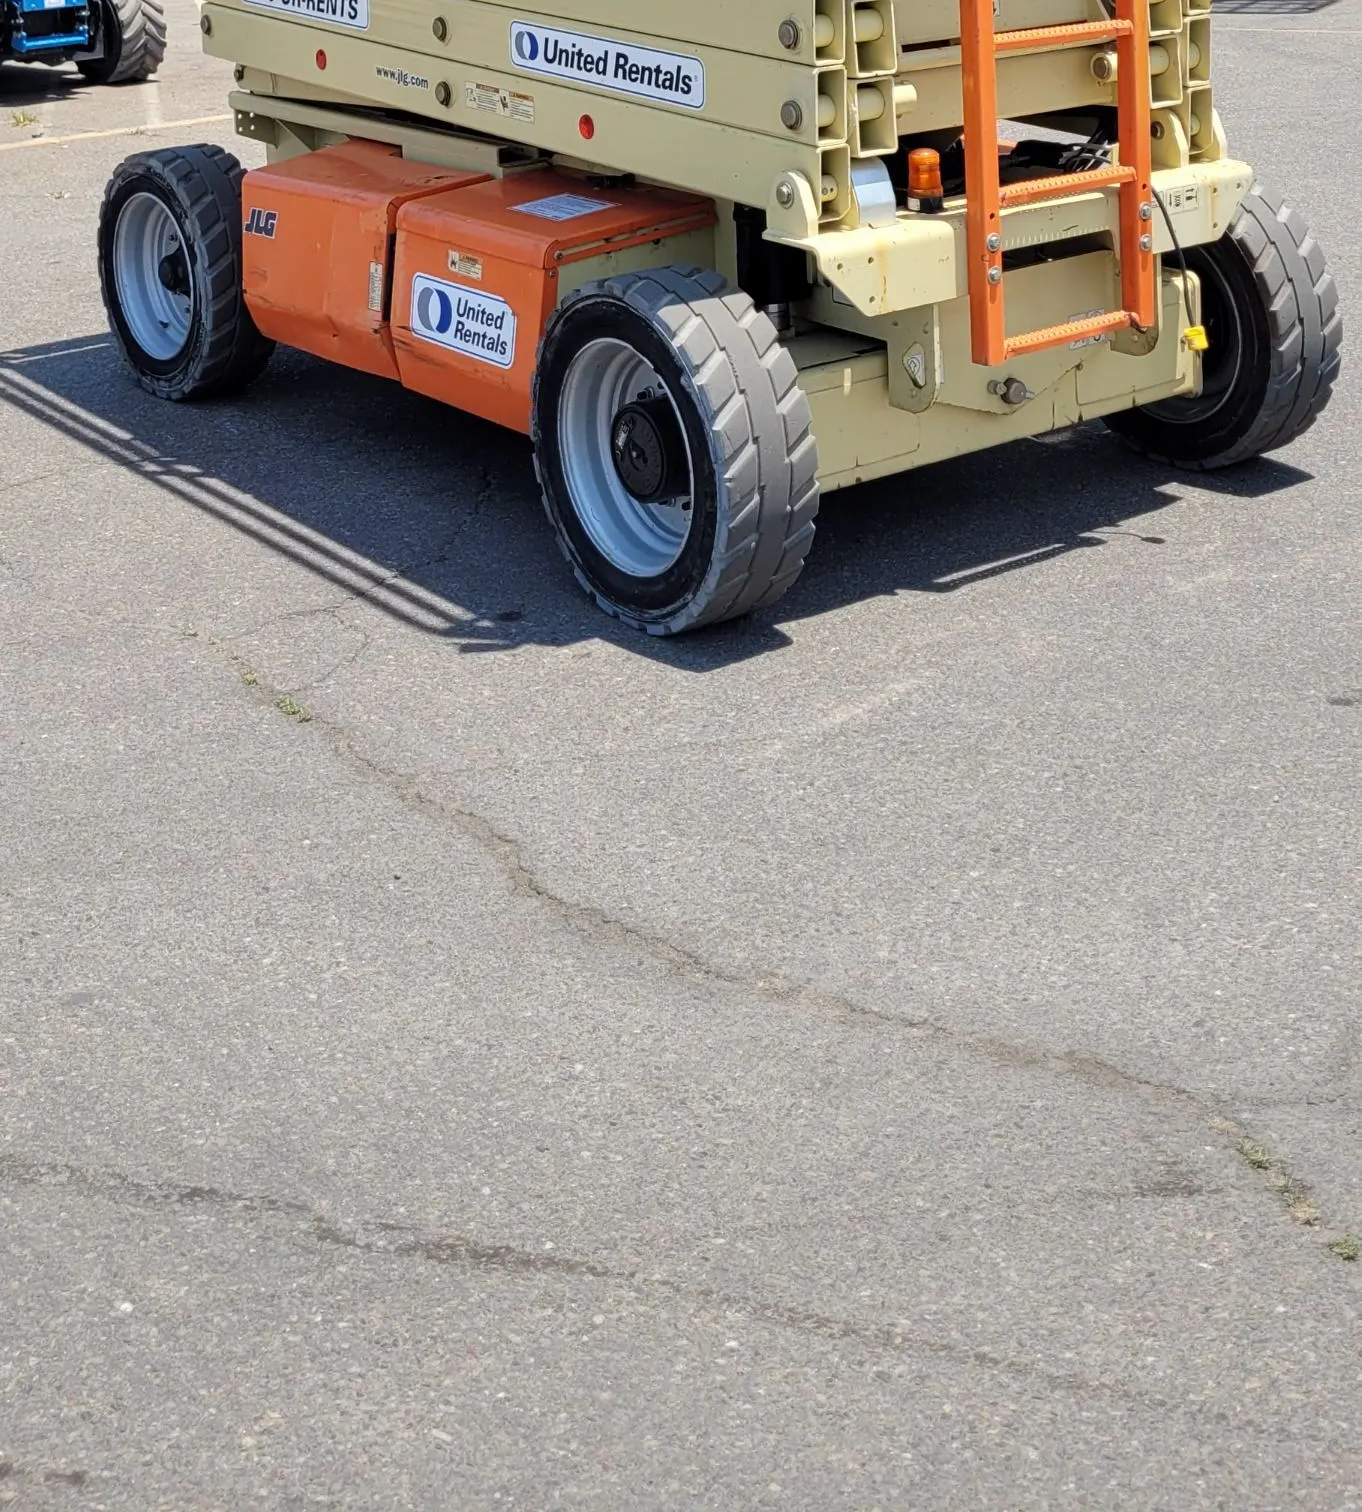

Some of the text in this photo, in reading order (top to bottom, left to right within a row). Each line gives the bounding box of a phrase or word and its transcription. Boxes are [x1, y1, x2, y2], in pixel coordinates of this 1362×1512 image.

[375, 65, 429, 88] www.jlg.com
[543, 37, 693, 95] United Rentals
[244, 208, 278, 238] JLG
[456, 296, 505, 331] United
[454, 319, 508, 356] Rentals
